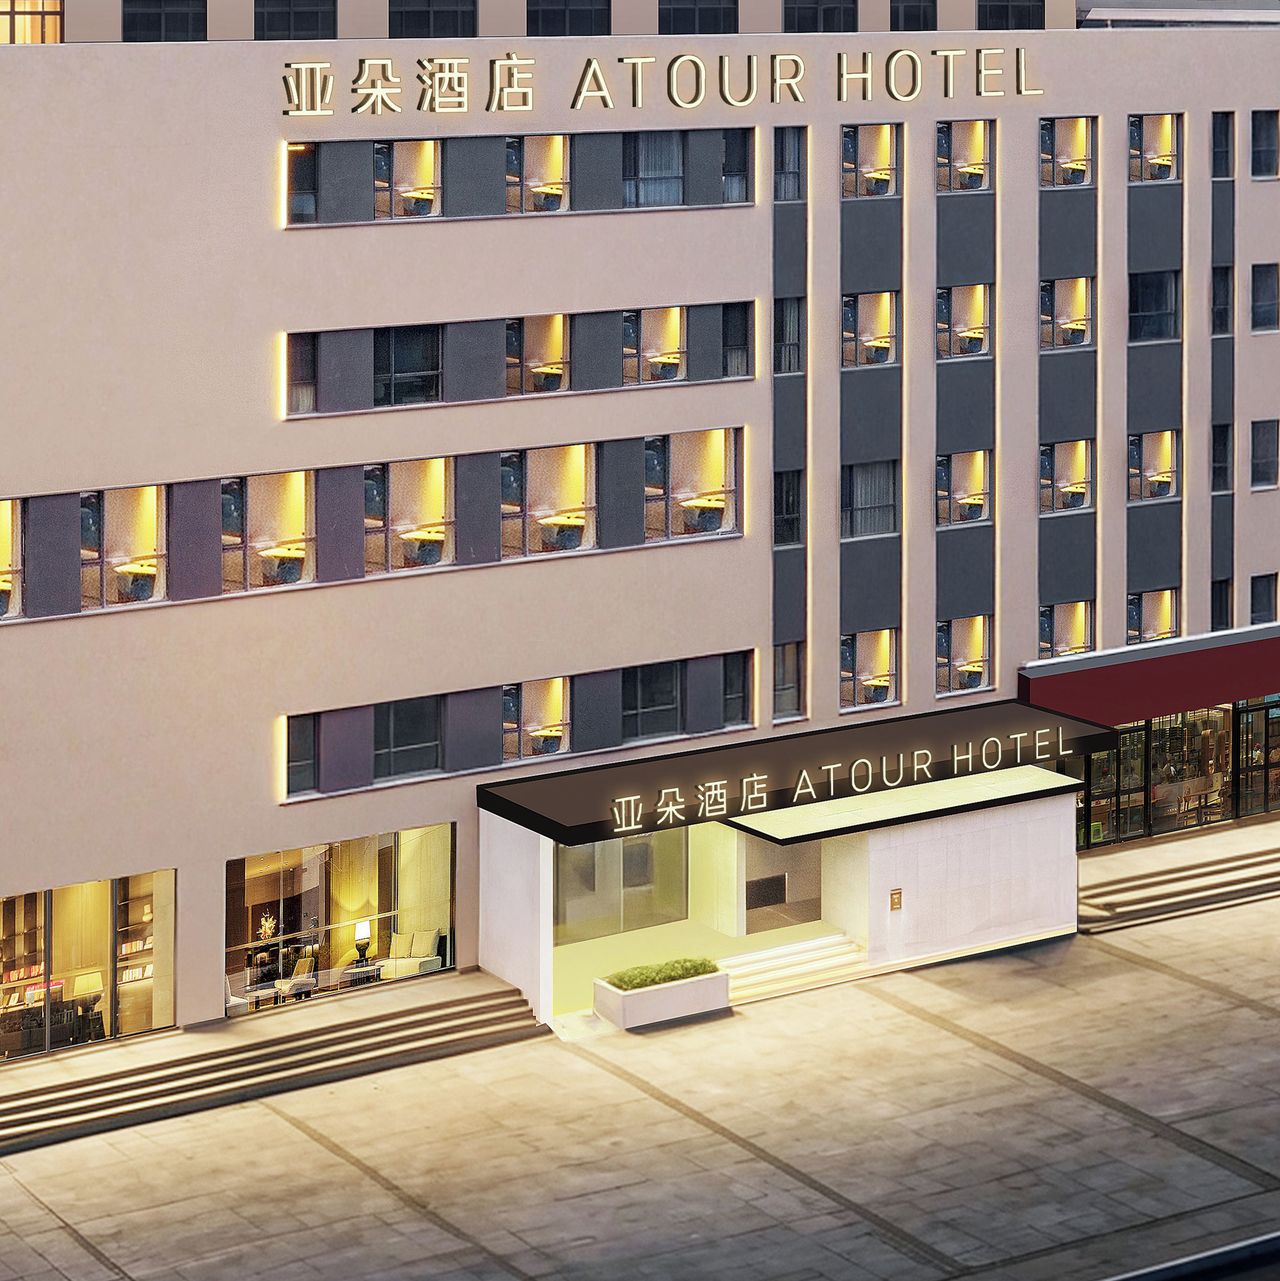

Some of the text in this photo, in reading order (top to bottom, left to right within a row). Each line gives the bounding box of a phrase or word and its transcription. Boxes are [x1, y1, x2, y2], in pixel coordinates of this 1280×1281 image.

[282, 48, 1044, 116] 亚朵酒店 ATOUR HOTEL
[612, 726, 1073, 832] 亚朵酒店 ATOUR HOTEL
